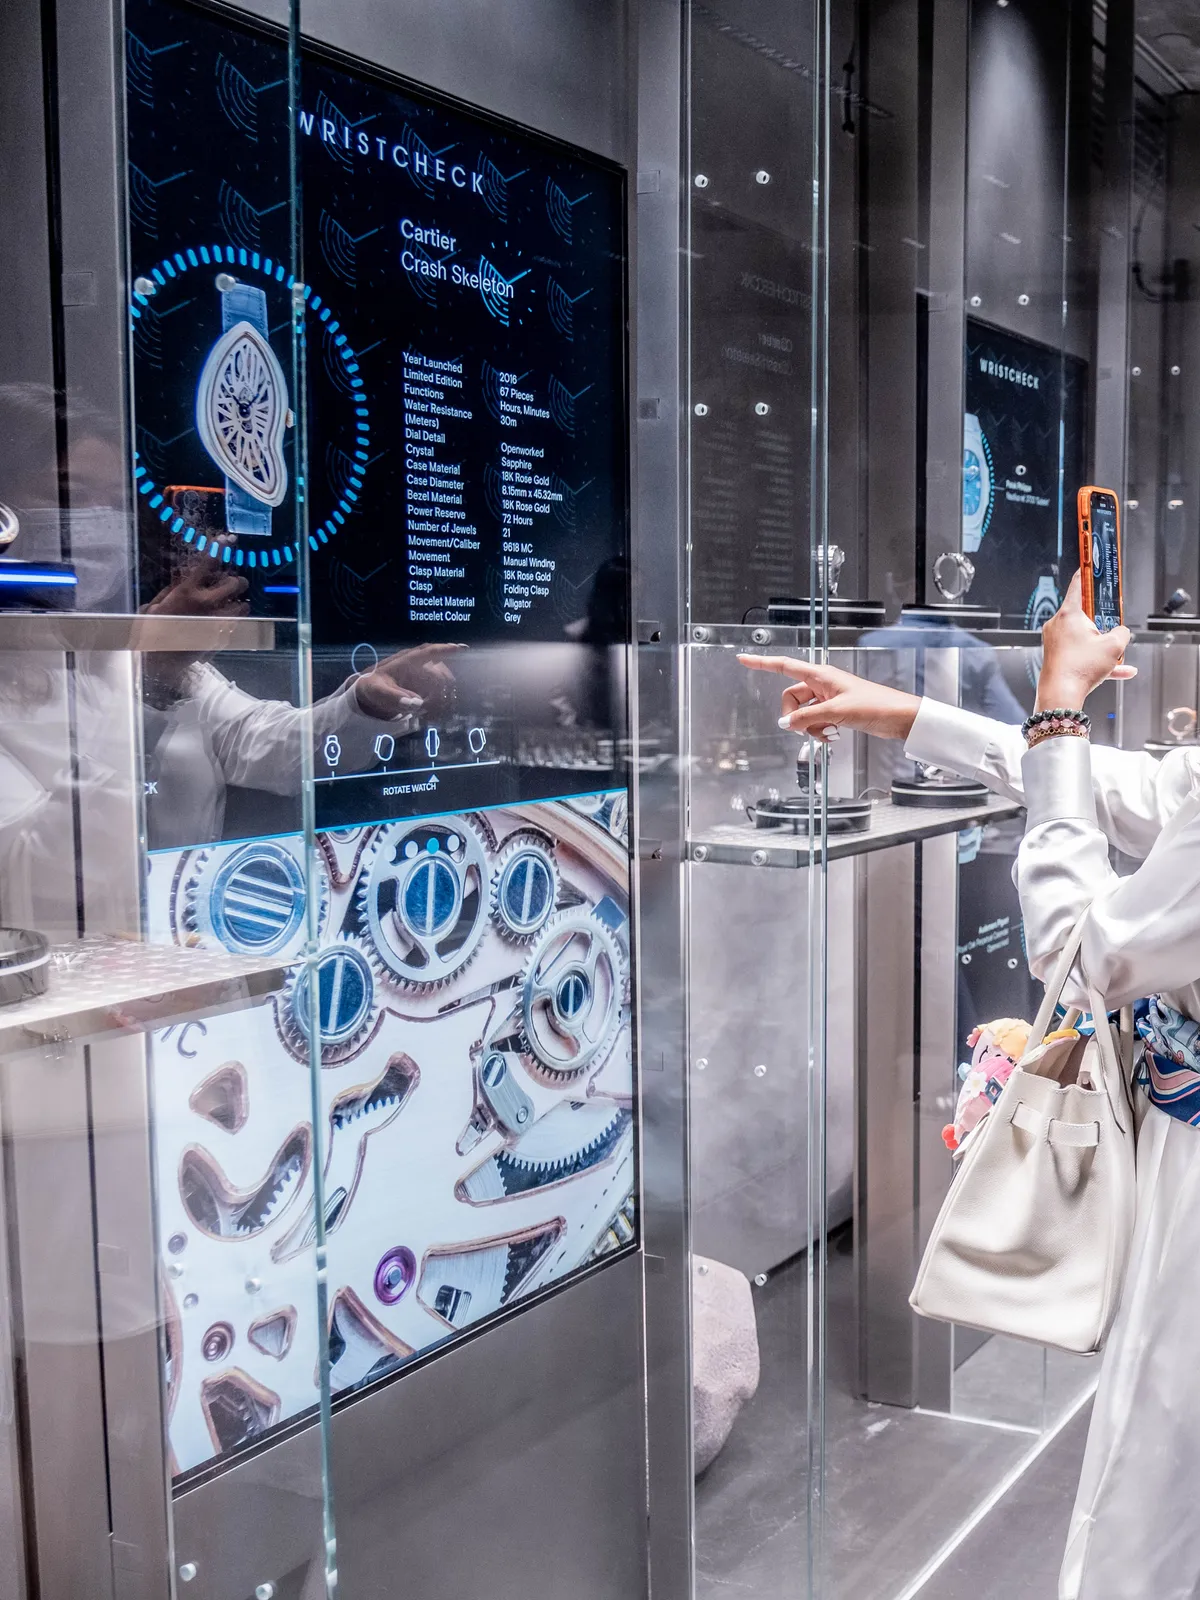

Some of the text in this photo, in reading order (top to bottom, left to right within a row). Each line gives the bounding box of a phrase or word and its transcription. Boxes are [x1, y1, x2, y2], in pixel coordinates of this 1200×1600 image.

[300, 111, 484, 195] WRISTCHECK
[401, 218, 457, 252] Cartier
[401, 251, 514, 298] Crash Skeleton
[403, 352, 462, 373] Year Launched
[404, 368, 462, 388] Limited Edition
[500, 372, 517, 384] 2016
[980, 358, 1040, 389] WRISTCHECK
[404, 384, 444, 400] Functions
[500, 387, 533, 401] 67 Pieces
[404, 399, 472, 419] Water Resistance
[524, 404, 549, 418] Minutes
[405, 413, 439, 429] (Meters)
[500, 415, 517, 427] 30m
[405, 428, 445, 443] Dial Detail
[406, 444, 434, 457] Crystal
[501, 443, 544, 458] Openworked
[406, 459, 460, 475] Case Material
[501, 458, 532, 470] Sapphire
[407, 474, 464, 490] Case Diameter
[502, 471, 549, 486] 18K Rose Gold
[407, 489, 462, 505] Bezel Material
[408, 504, 465, 519] Power Reserve
[502, 500, 550, 513] 18K Rose Gold
[502, 514, 533, 525] 72 Hours
[408, 520, 476, 535] Number of Jewels
[503, 528, 510, 538] 21
[408, 535, 480, 550] Movement/Caliber
[521, 544, 533, 553] MC
[409, 550, 450, 562] Movement
[504, 557, 555, 570] Manual Winding
[409, 565, 464, 577] Clasp Material
[504, 571, 550, 581] 18K Rose Gold
[410, 581, 432, 593] Clasp
[504, 585, 549, 597] Folding Clasp
[410, 596, 474, 607] Bracelet Material
[504, 599, 531, 610] Alligator
[410, 611, 470, 621] Bracelet Colour
[505, 612, 521, 624] Grey
[383, 782, 437, 796] ROTATE WATCH
